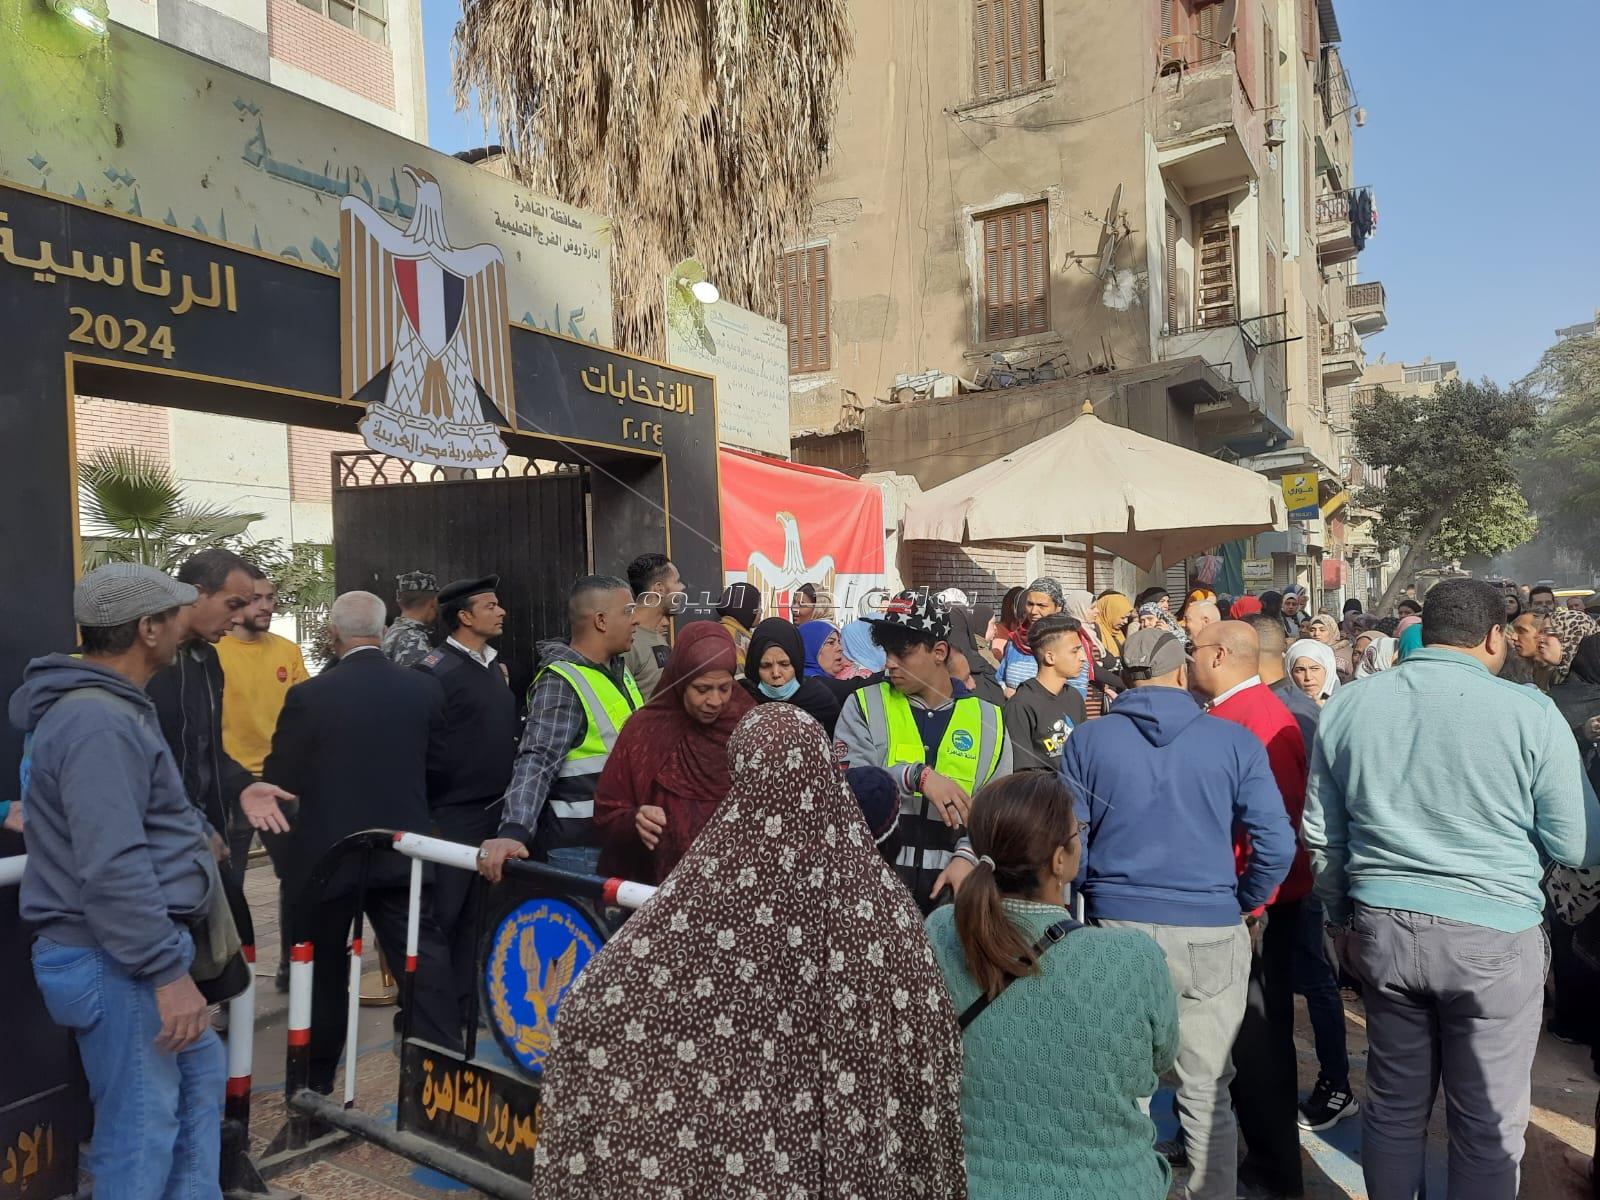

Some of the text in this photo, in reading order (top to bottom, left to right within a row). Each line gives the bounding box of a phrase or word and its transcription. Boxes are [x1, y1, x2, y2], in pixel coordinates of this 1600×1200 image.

[494, 210, 537, 237] التعليمية
[514, 194, 583, 229] محافظة القاهرة
[563, 238, 582, 256] روض
[68, 306, 176, 360] 2024
[581, 363, 694, 416] الانتخابات
[372, 419, 498, 463] جمهورية مصر العربية
[422, 1058, 490, 1127] القاهرة
